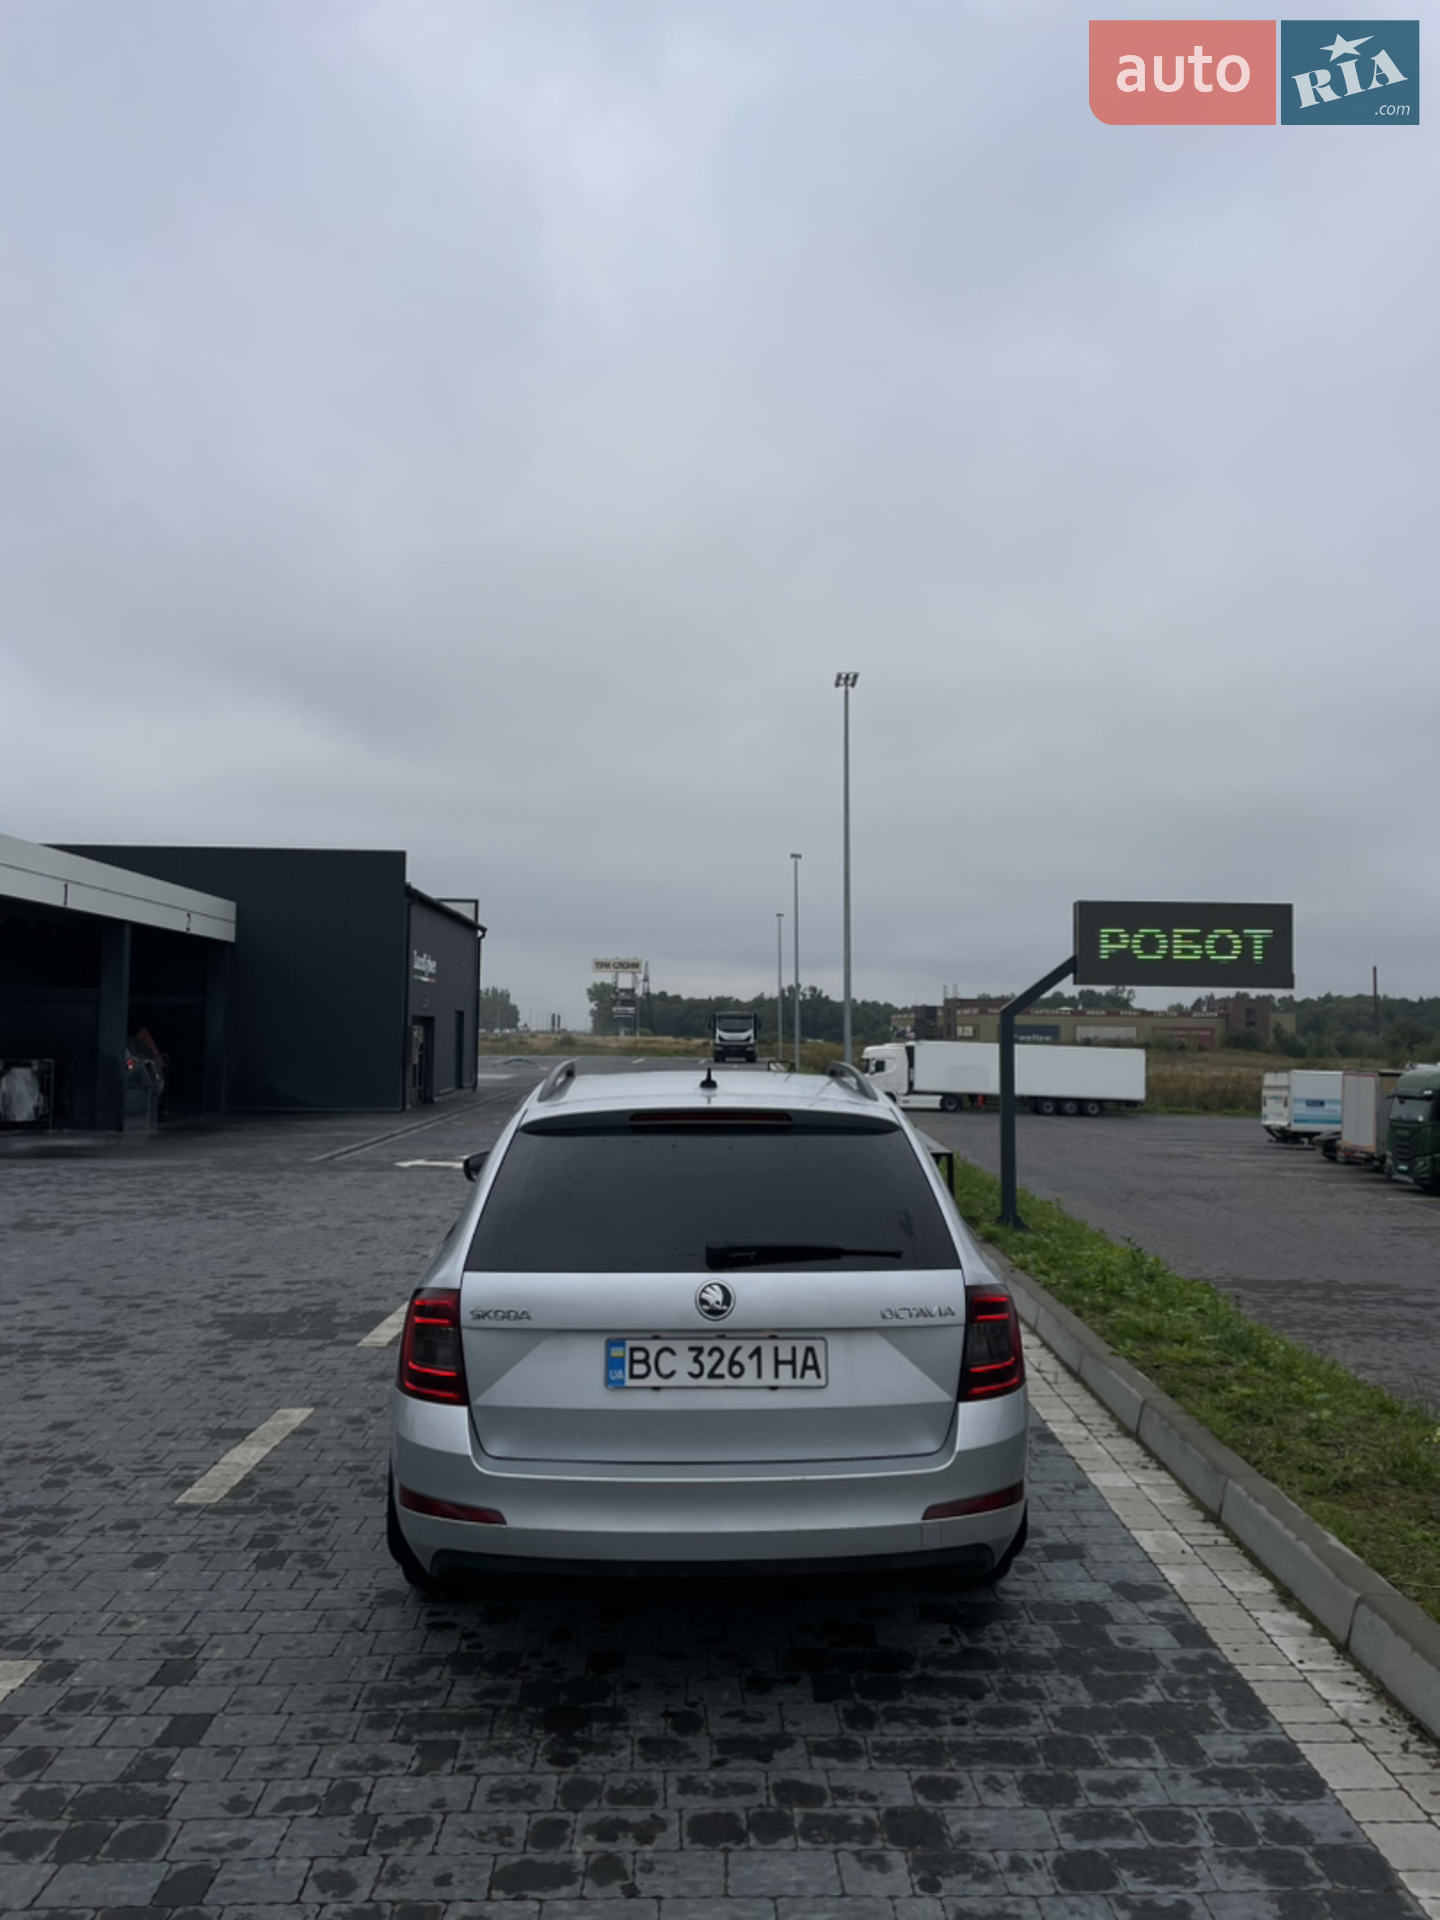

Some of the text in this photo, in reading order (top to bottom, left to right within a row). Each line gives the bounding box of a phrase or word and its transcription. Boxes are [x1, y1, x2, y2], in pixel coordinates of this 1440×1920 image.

[63, 883, 69, 906] 1
[1099, 928, 1275, 965] РОБОТ
[880, 1306, 957, 1320] OCTAVIA
[628, 1346, 822, 1380] BC 3261 HA
[609, 1369, 625, 1381] UA
